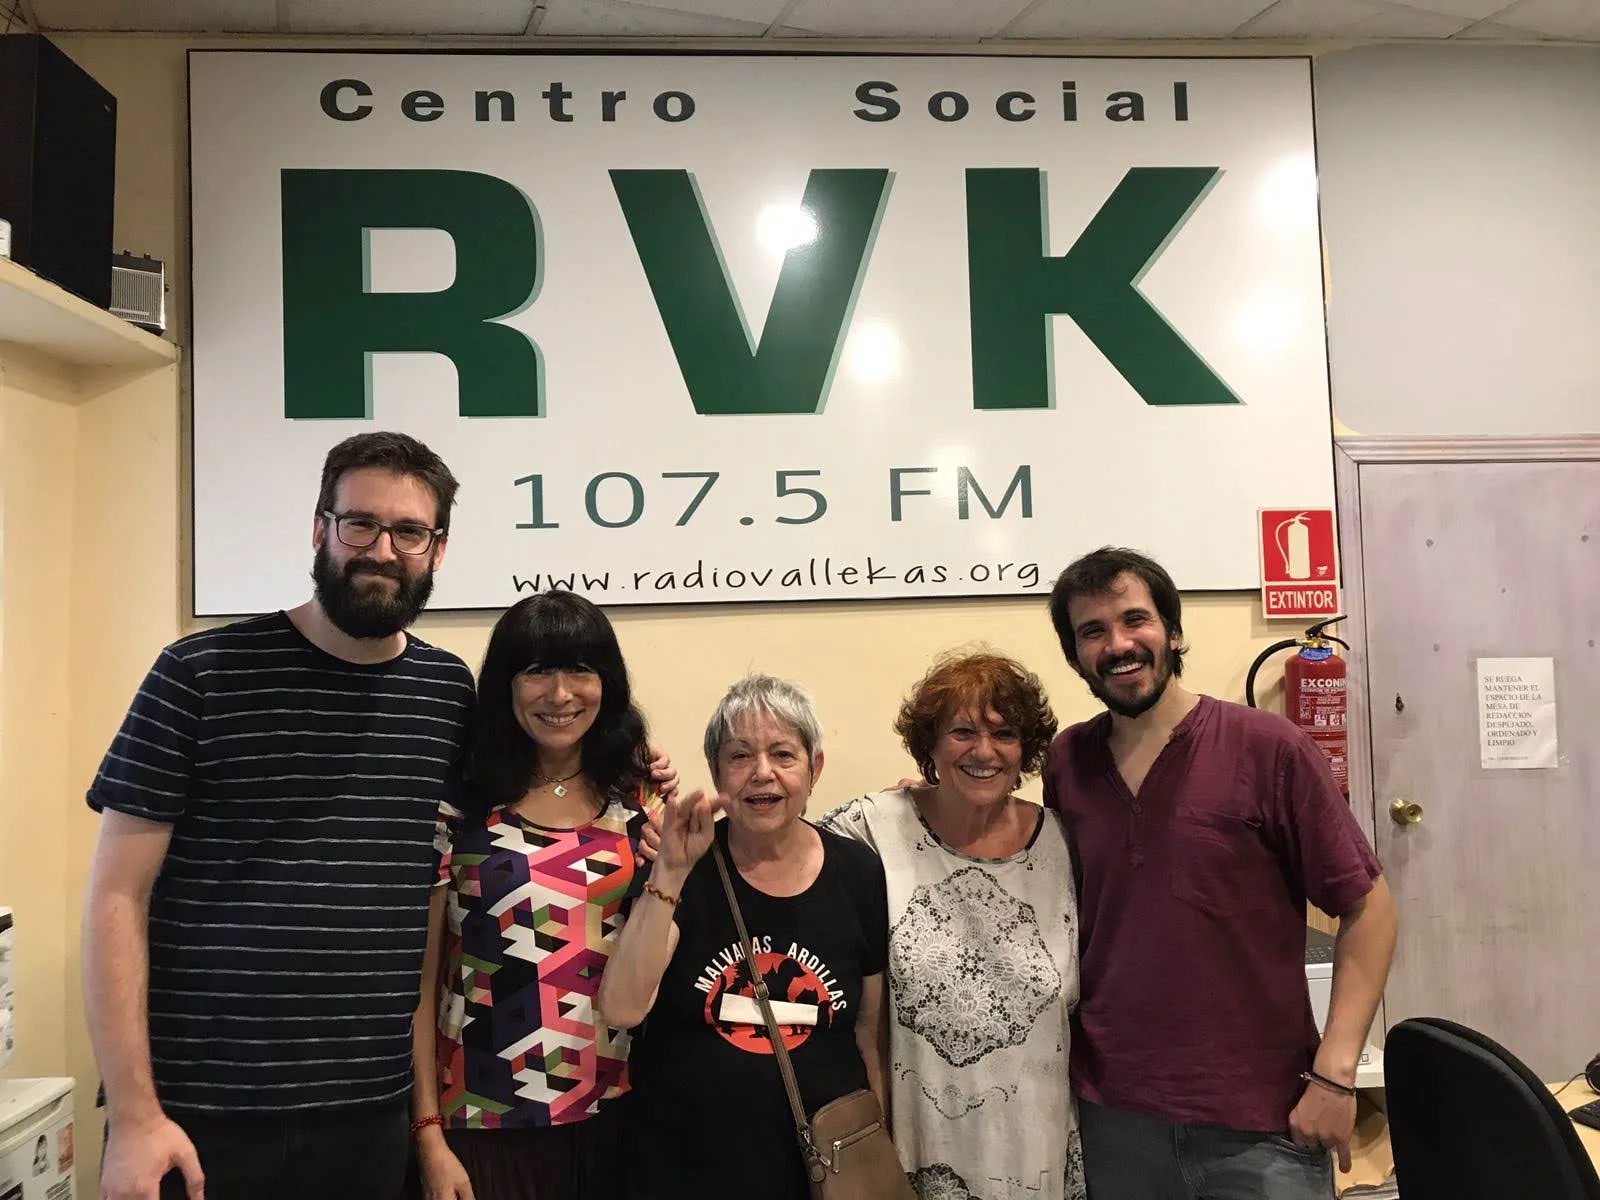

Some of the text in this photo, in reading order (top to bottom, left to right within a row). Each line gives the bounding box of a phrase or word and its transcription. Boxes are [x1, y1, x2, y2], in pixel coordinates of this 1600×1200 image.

[320, 79, 1191, 123] Centro Social
[280, 166, 1246, 419] RVK
[513, 464, 1033, 530] 107.5 FM
[512, 556, 1041, 592] www.radiovallekas.org
[1269, 590, 1334, 609] EXTINTOR
[1484, 675, 1523, 683] SE RUEGA
[1485, 684, 1529, 692] MANTENER
[1485, 693, 1542, 701] ESPACIO DE LA
[1509, 702, 1519, 710] DE
[1487, 730, 1531, 738] ORDENADO
[1487, 739, 1515, 747] LIMPIO
[787, 942, 848, 1012] ARDILLAS
